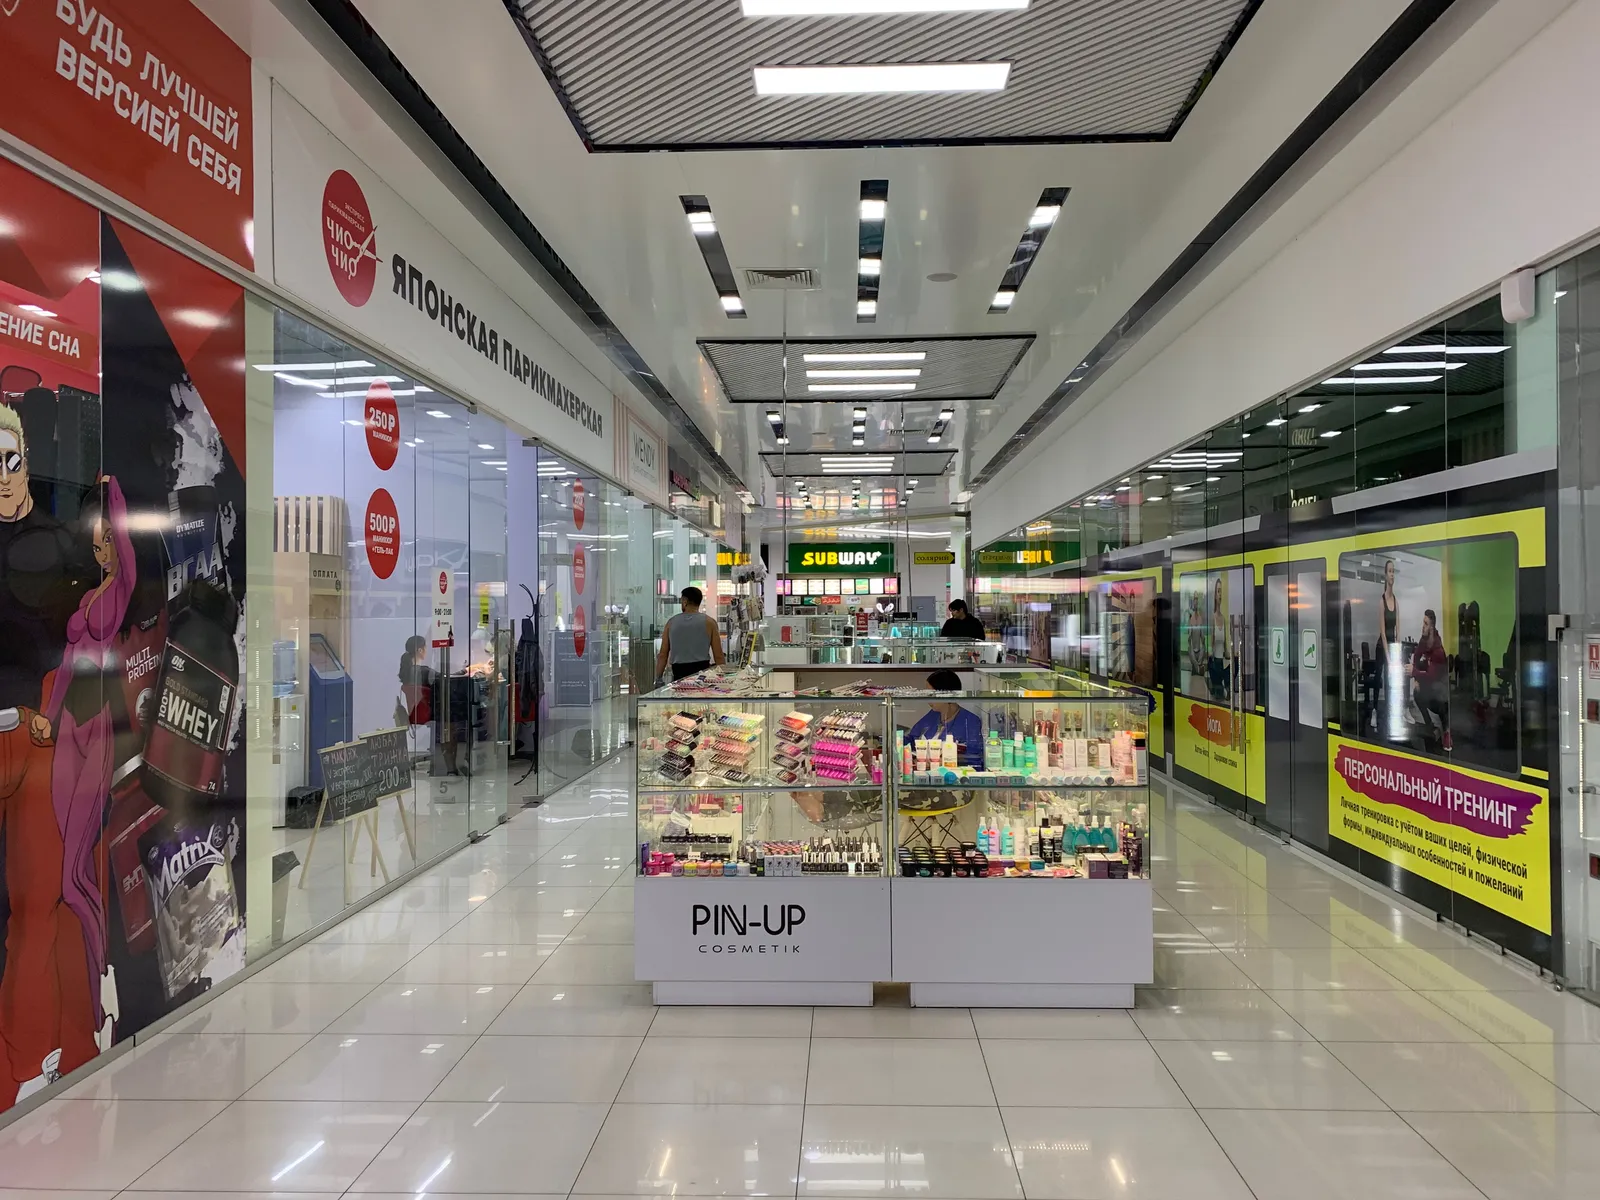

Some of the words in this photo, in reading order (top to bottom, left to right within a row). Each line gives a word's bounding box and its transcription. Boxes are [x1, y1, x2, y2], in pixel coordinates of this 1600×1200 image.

[55, 38, 180, 154] ВЕРСИЕЙ
[186, 133, 242, 196] СЕБЯ
[139, 51, 239, 151] ЛУЧШЕЙ
[326, 216, 353, 250] ЧИО
[331, 244, 358, 278] ЧИО
[48, 330, 80, 359] СНА
[392, 253, 499, 365] ЯПОНСКАЯ
[503, 338, 603, 438] ПАРИКМАХЕРСКАЯ
[633, 431, 656, 470] WENDY
[176, 518, 205, 533] DYMATIZE
[312, 569, 338, 579] ОПЛАТА
[801, 550, 883, 567] SUBWAY
[916, 553, 950, 563] солярий
[126, 646, 151, 671] MULTI
[128, 652, 163, 684] PROTEIN
[167, 691, 219, 744] WHEY
[1206, 715, 1222, 736] ЙОГА
[378, 766, 400, 792] 200
[1343, 757, 1442, 806] ПЕРСОНАЛЬНЫЙ
[1444, 786, 1518, 829] ТРЕНИНГ
[1340, 796, 1360, 813] Личная
[1361, 805, 1394, 827] тренировка
[1395, 819, 1399, 829] с
[1400, 820, 1424, 838] учётом
[1425, 830, 1447, 848] ваших
[1448, 838, 1474, 861] целей,
[1475, 846, 1528, 879] физической
[148, 823, 225, 919] Matrix
[1343, 814, 1364, 835] формы,
[1365, 825, 1416, 856] индивидуальных
[1417, 847, 1467, 877] особенностей
[1468, 868, 1474, 880] и
[1475, 871, 1524, 902] пожеланий
[692, 904, 806, 936] PIN-UP
[698, 945, 800, 953] COSMETIK
